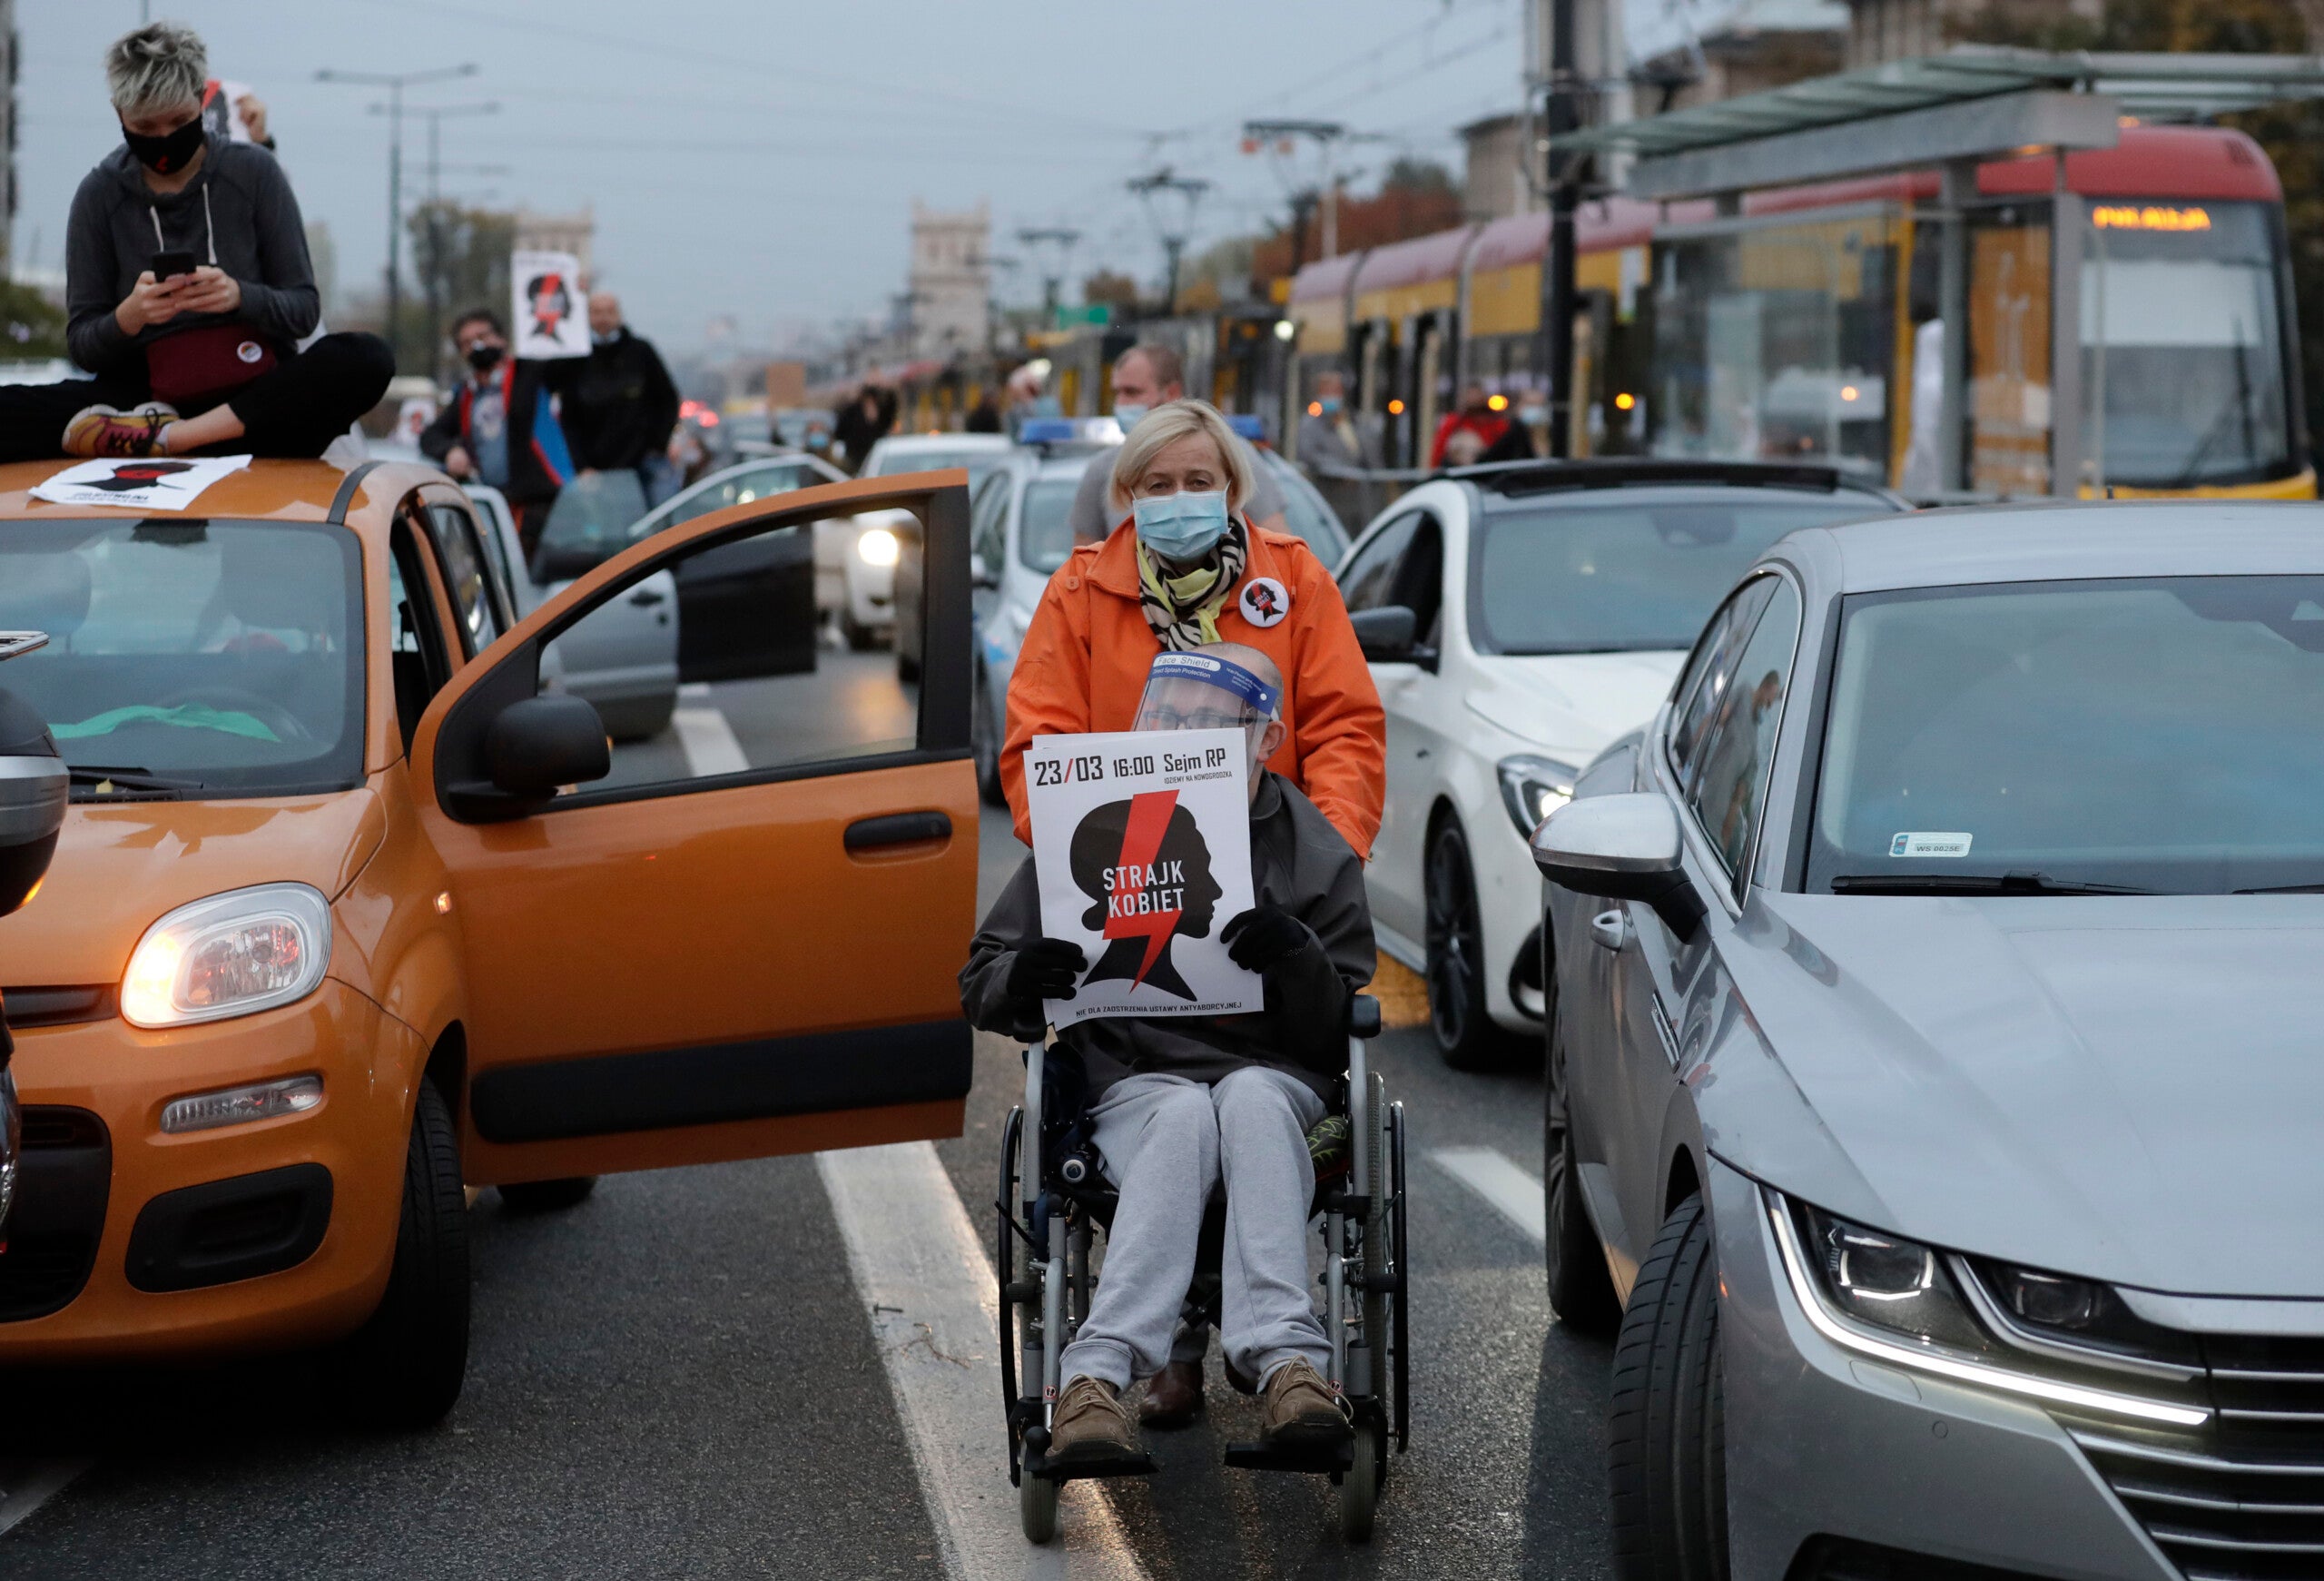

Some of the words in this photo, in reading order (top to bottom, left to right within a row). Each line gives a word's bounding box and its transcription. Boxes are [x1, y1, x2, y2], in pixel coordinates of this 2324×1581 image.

[1158, 657, 1177, 665] Face
[1180, 657, 1211, 668] Shield
[1182, 667, 1211, 678] Protection
[1034, 756, 1103, 786] 23/03
[1113, 756, 1155, 778] 16:00
[1164, 753, 1202, 773] Sejm
[1206, 747, 1226, 767] RP
[1164, 776, 1184, 785] IDZIEMY
[1102, 860, 1185, 891] STRAJK
[1108, 888, 1184, 918] KOBIET
[1076, 1008, 1087, 1017] NIE
[1088, 1006, 1101, 1014] DLA
[1179, 1002, 1242, 1012] ANTYABORCYJNEJ
